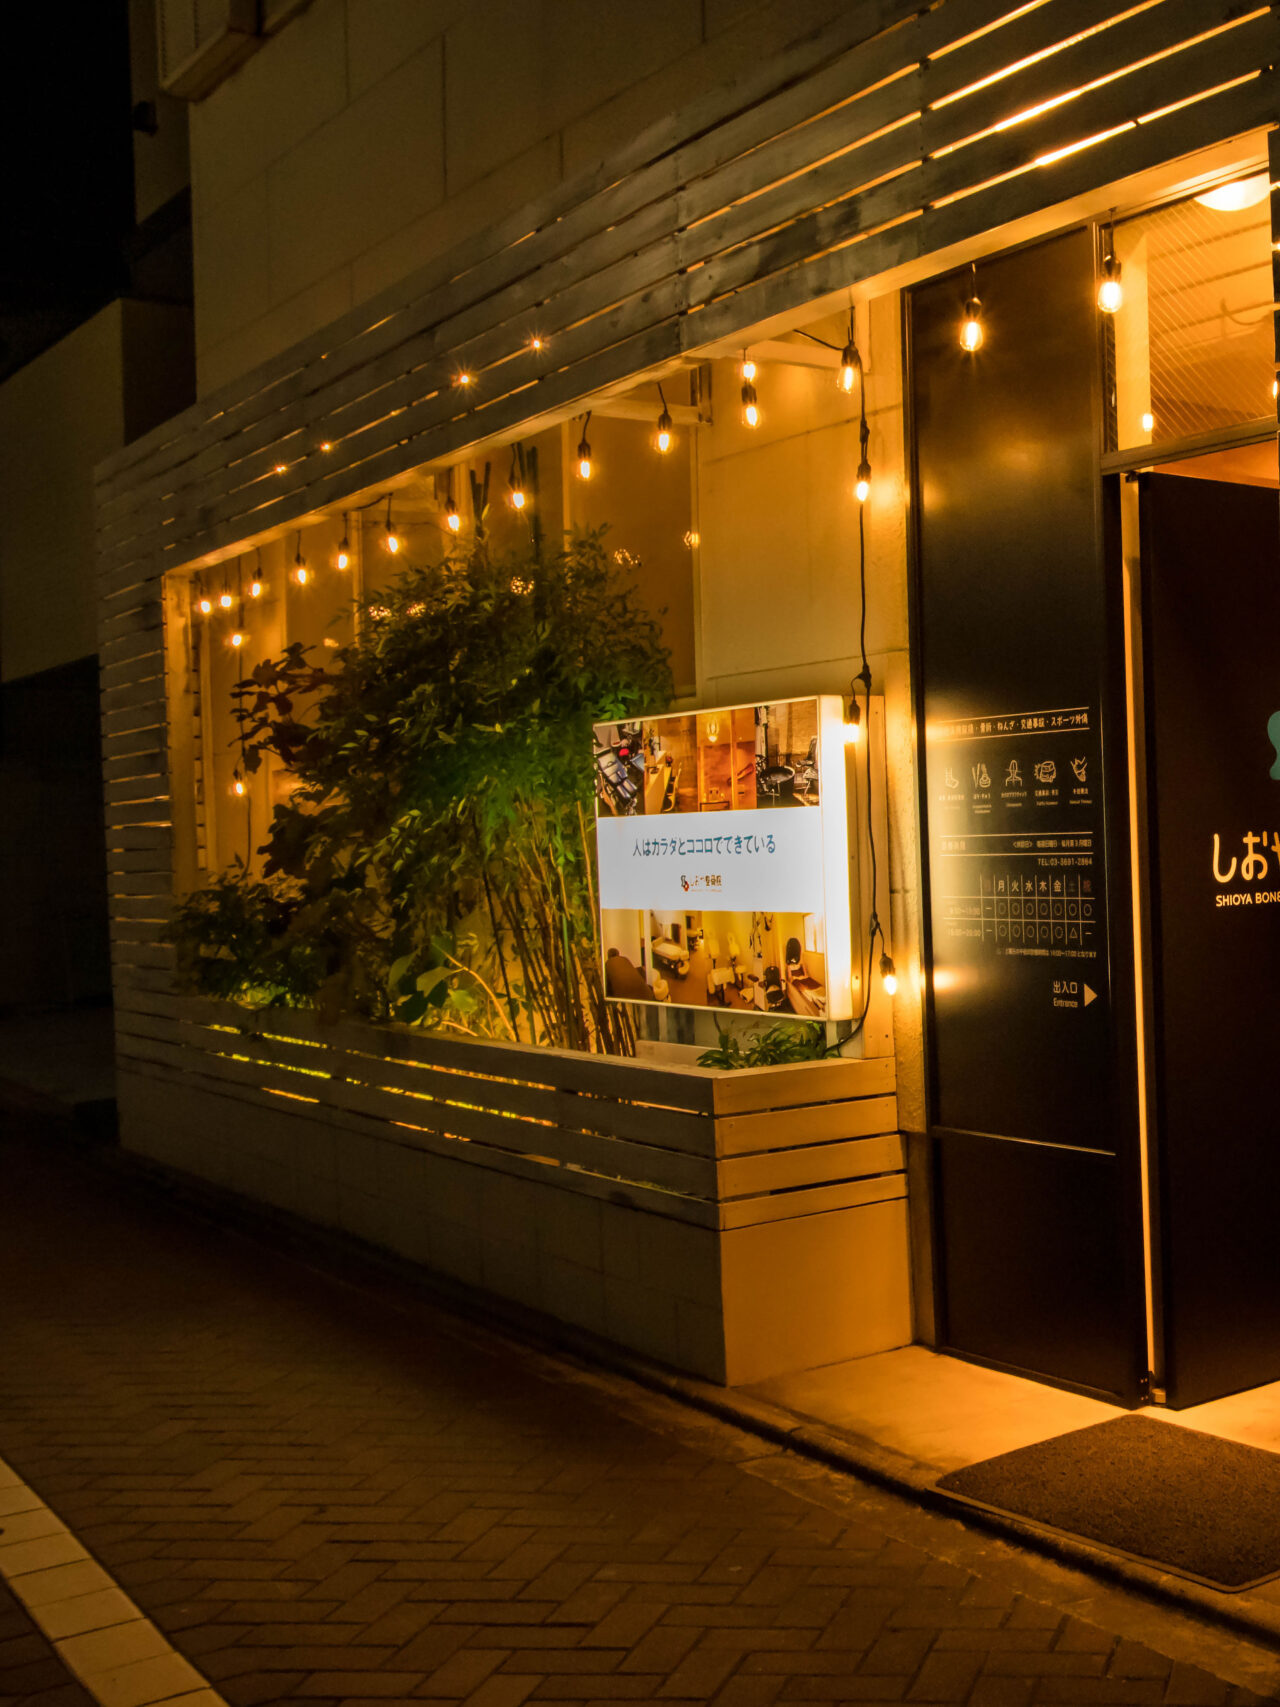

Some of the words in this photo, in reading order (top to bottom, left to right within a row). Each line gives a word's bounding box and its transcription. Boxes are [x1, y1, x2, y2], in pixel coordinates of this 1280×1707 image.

[632, 834, 776, 857] 人はカラダとココロでできている
[997, 879, 1005, 892] 月
[1011, 879, 1019, 892] 火
[1025, 879, 1034, 892] 水
[1039, 879, 1047, 892] 木
[1053, 879, 1062, 892] 金
[1215, 893, 1253, 908] SHIOYA
[1053, 980, 1078, 994] 出入口
[1053, 997, 1078, 1008] Entrance
